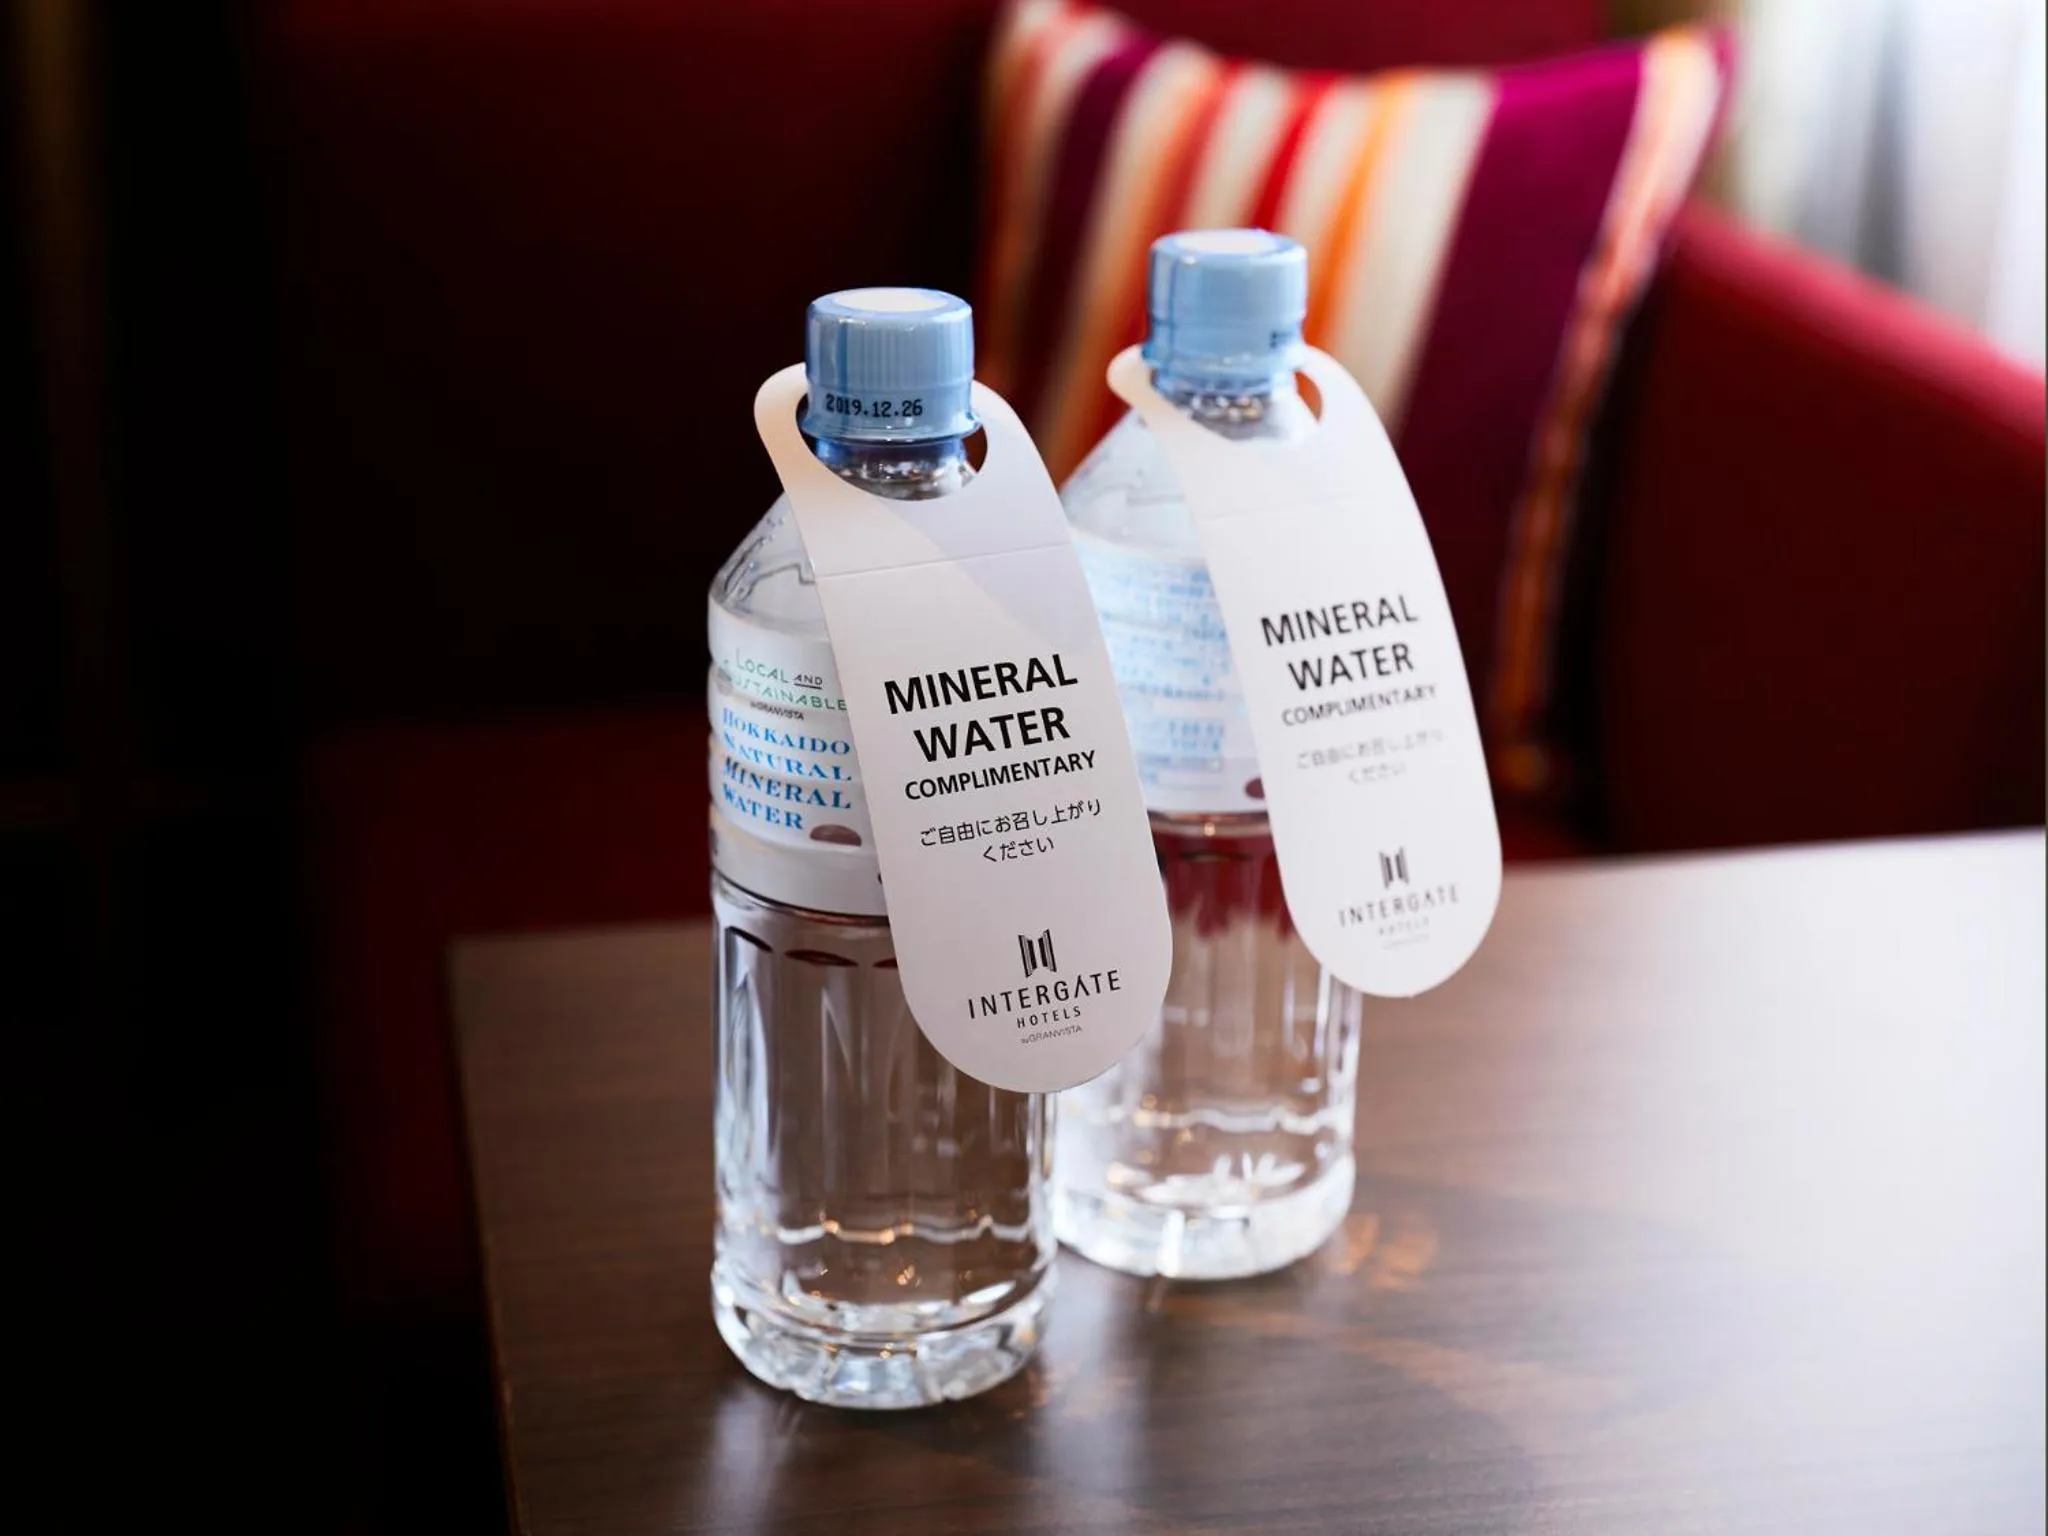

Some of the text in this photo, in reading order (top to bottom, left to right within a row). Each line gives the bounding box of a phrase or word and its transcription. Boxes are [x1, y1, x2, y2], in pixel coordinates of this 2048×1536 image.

[825, 393, 923, 418] 2019.12.26
[1260, 594, 1418, 646] MINERAL
[735, 647, 823, 689] LOCAL AND
[884, 653, 1078, 715] MINERAL
[1288, 643, 1413, 691] WATER
[1282, 685, 1437, 727] COMPLIMENTARY
[723, 706, 851, 756] HOKKAIDO
[913, 706, 1071, 762] WATER
[723, 731, 852, 782] NATURAL
[905, 750, 1096, 800] COMPLIMENTARY
[723, 783, 804, 830] WATER
[724, 756, 852, 810] MINERAL
[920, 799, 1102, 847] ご自由にお召し上がり
[983, 837, 1054, 862] ください
[1338, 884, 1459, 928] INTERGATE
[968, 970, 1121, 1020] INTERGATE
[1016, 1006, 1081, 1029] HOTELS
